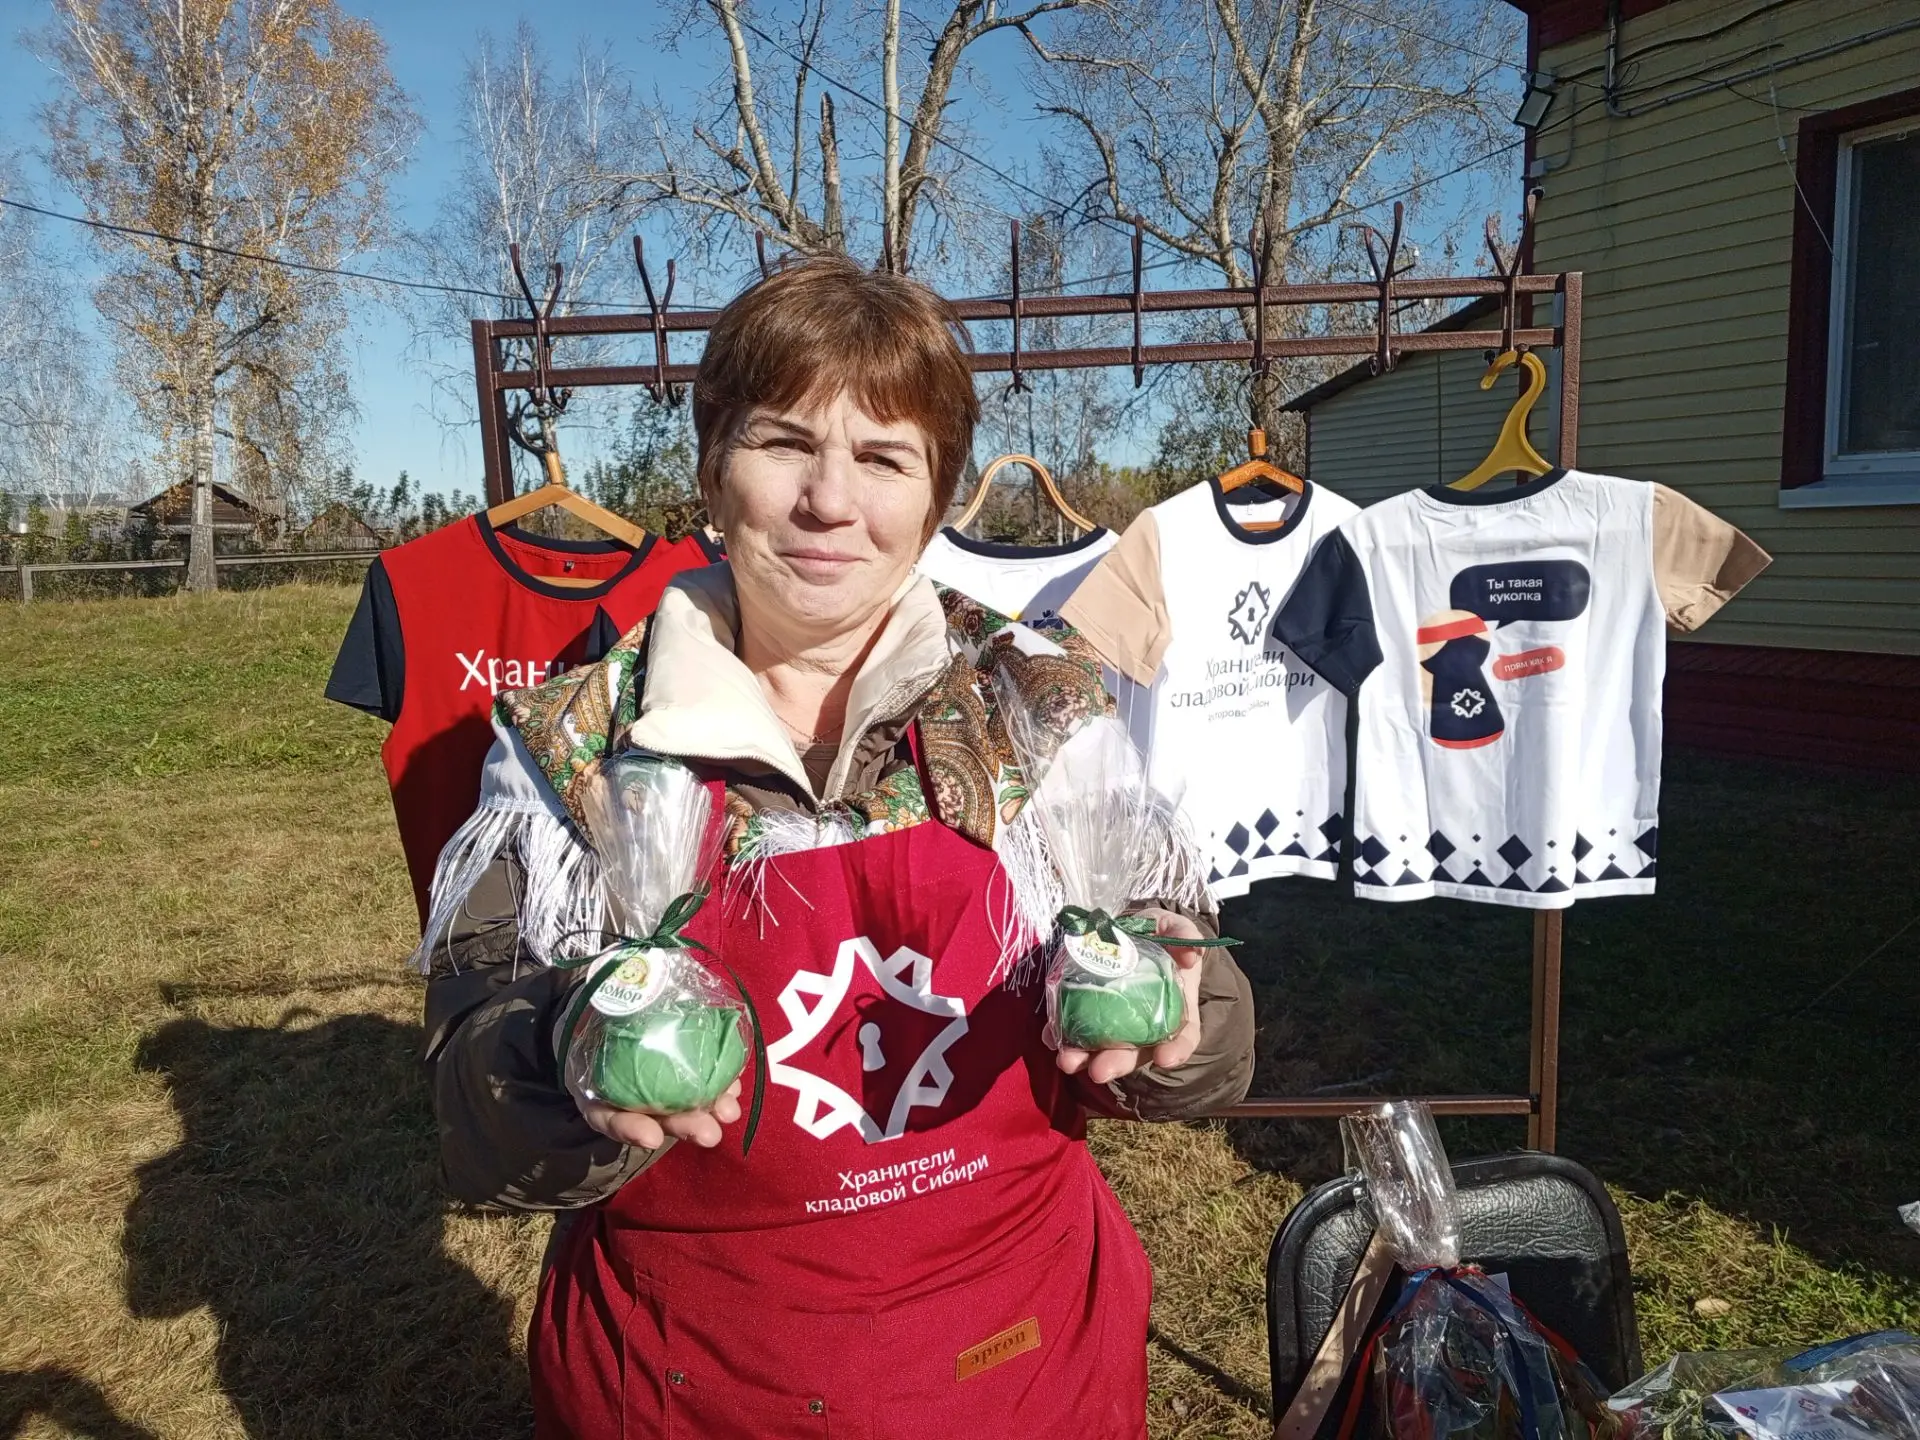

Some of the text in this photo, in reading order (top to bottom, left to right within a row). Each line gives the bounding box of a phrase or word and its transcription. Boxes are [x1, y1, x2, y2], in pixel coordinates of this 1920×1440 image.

[1486, 578, 1543, 590] Ты такая
[1489, 592, 1542, 605] куколка
[454, 648, 565, 697] Хран
[805, 1154, 990, 1214] кладовой Сибири
[837, 1147, 956, 1193] Хранители
[970, 1331, 1027, 1366] apron
